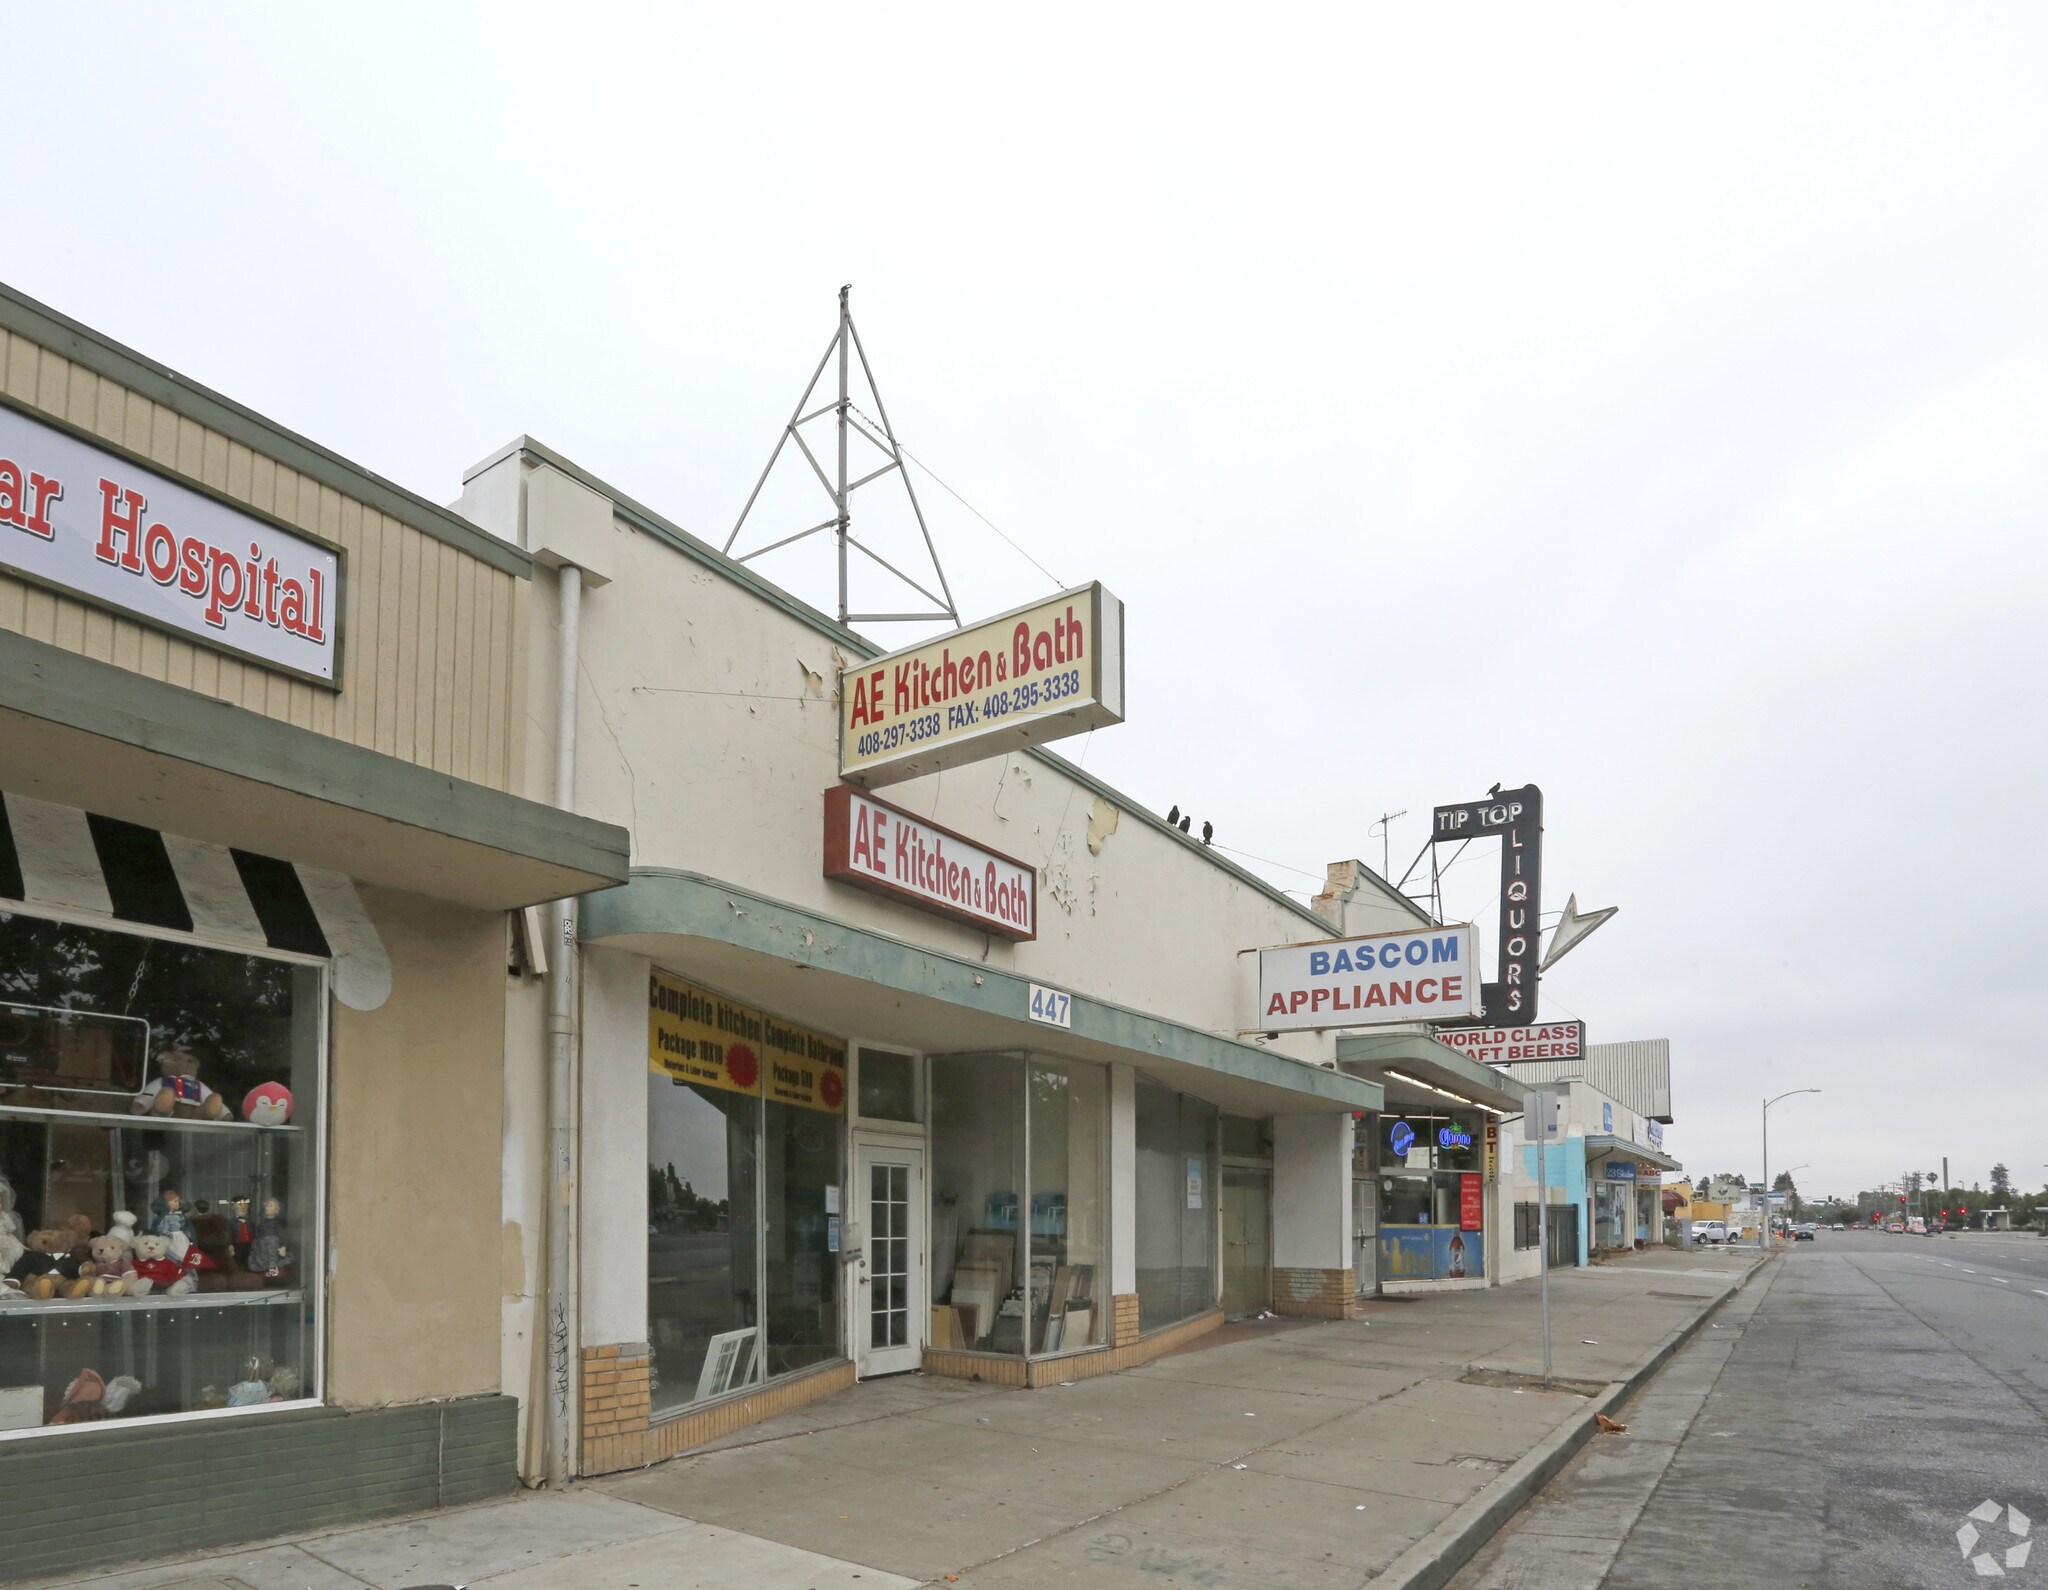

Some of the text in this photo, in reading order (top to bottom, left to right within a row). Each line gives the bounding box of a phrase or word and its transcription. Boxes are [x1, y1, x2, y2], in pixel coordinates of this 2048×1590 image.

[95, 477, 327, 644] Hospital
[850, 606, 1084, 730] AE Kitchen & Bath
[858, 669, 1080, 757] 408-297-3338 FAX: 408-295-3338
[1437, 802, 1523, 831] TIP TOP
[853, 803, 1028, 927] AE Kitchen & Bath
[1507, 828, 1528, 1012] LIQUORS
[1310, 936, 1459, 976] BASCOM
[649, 975, 713, 1027] Complete
[1031, 989, 1070, 1024] 447
[1266, 976, 1463, 1016] APPLIANCE
[658, 1026, 697, 1061] Package
[765, 1018, 805, 1056] Complete
[1436, 1025, 1578, 1047] WORLD CLASS
[1466, 1042, 1579, 1061] AFT BEERS
[1486, 1112, 1497, 1154] EBT
